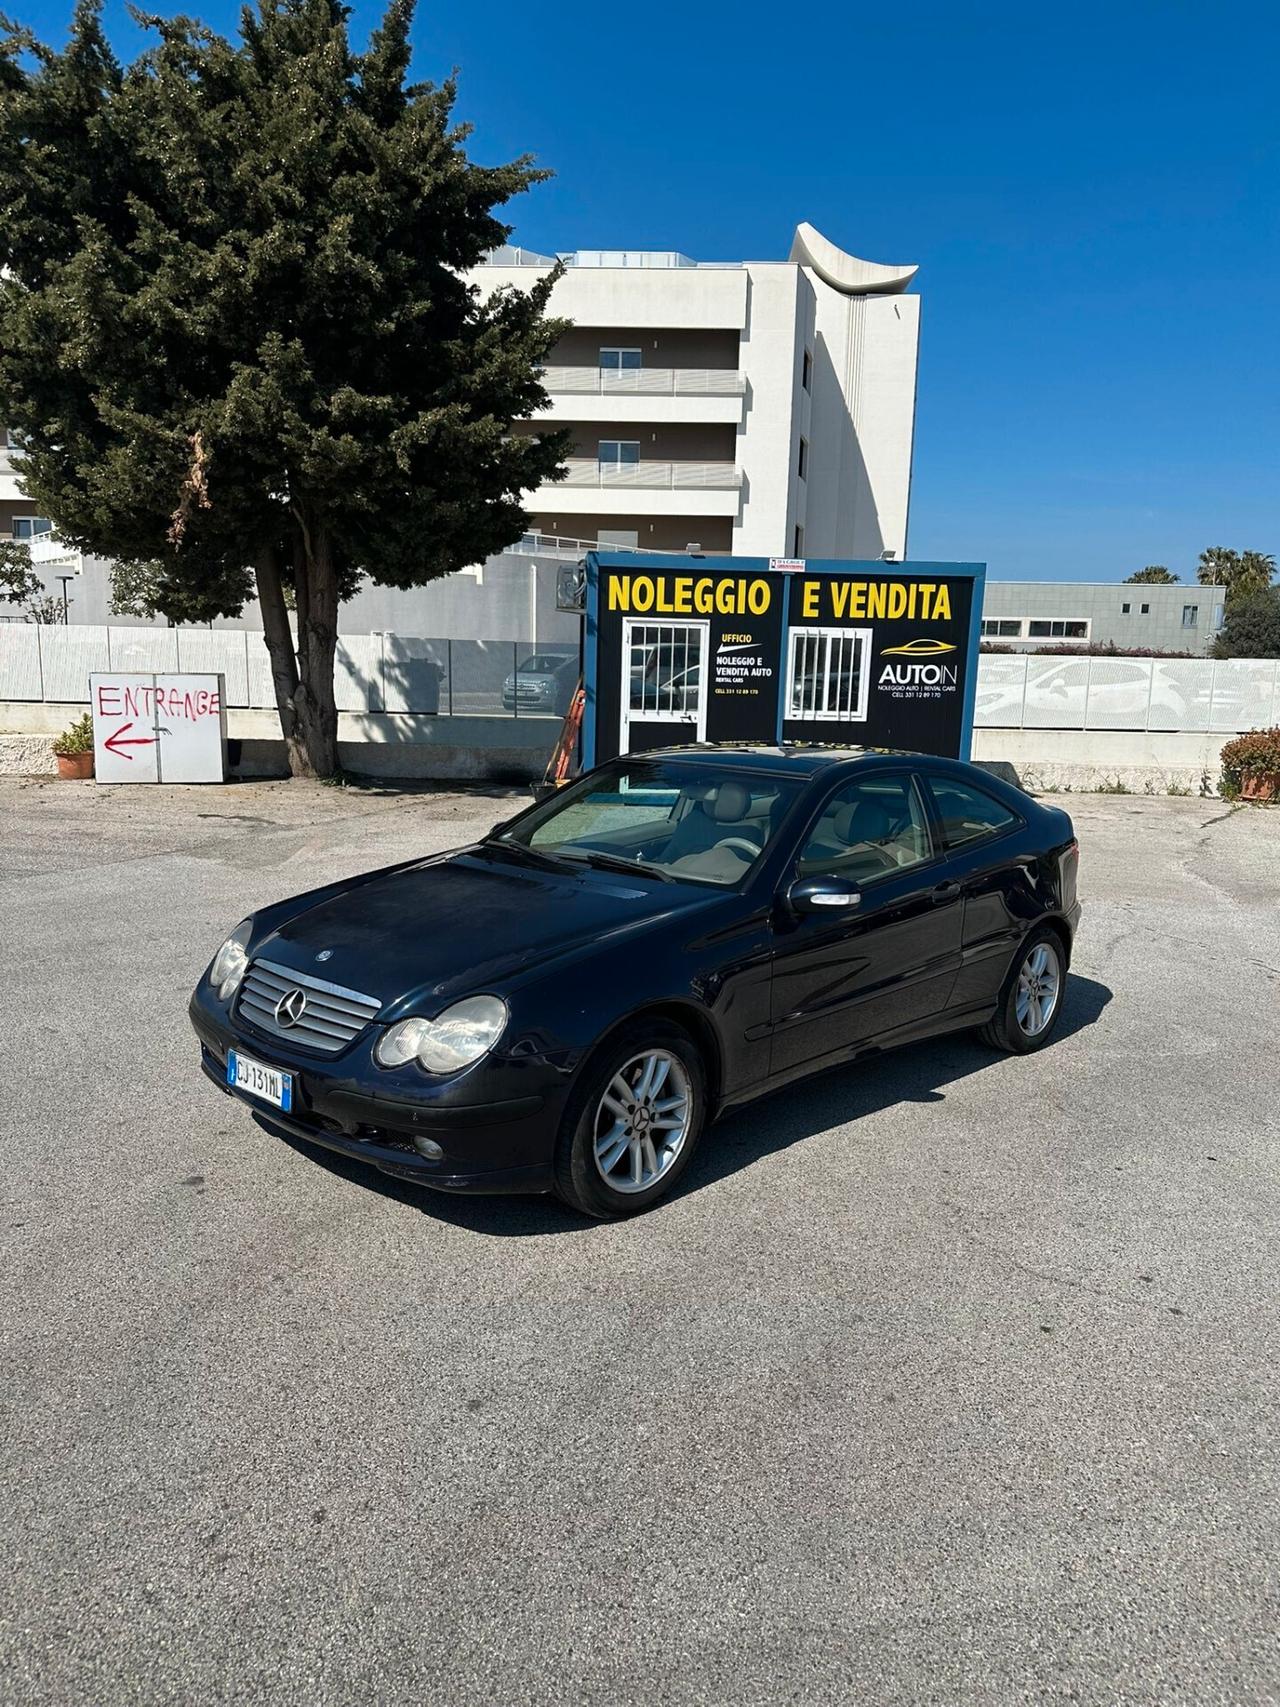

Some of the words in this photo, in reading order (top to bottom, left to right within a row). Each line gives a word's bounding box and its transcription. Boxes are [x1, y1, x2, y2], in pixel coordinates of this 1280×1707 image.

[608, 575, 771, 616] NOLEGGIO
[803, 581, 820, 618] E
[831, 582, 952, 621] VENDITA
[721, 634, 752, 643] UFFICIO
[716, 656, 755, 666] NOLEGGIO
[757, 657, 763, 666] E
[716, 667, 749, 676] VENDITA
[751, 667, 772, 677] AUTO
